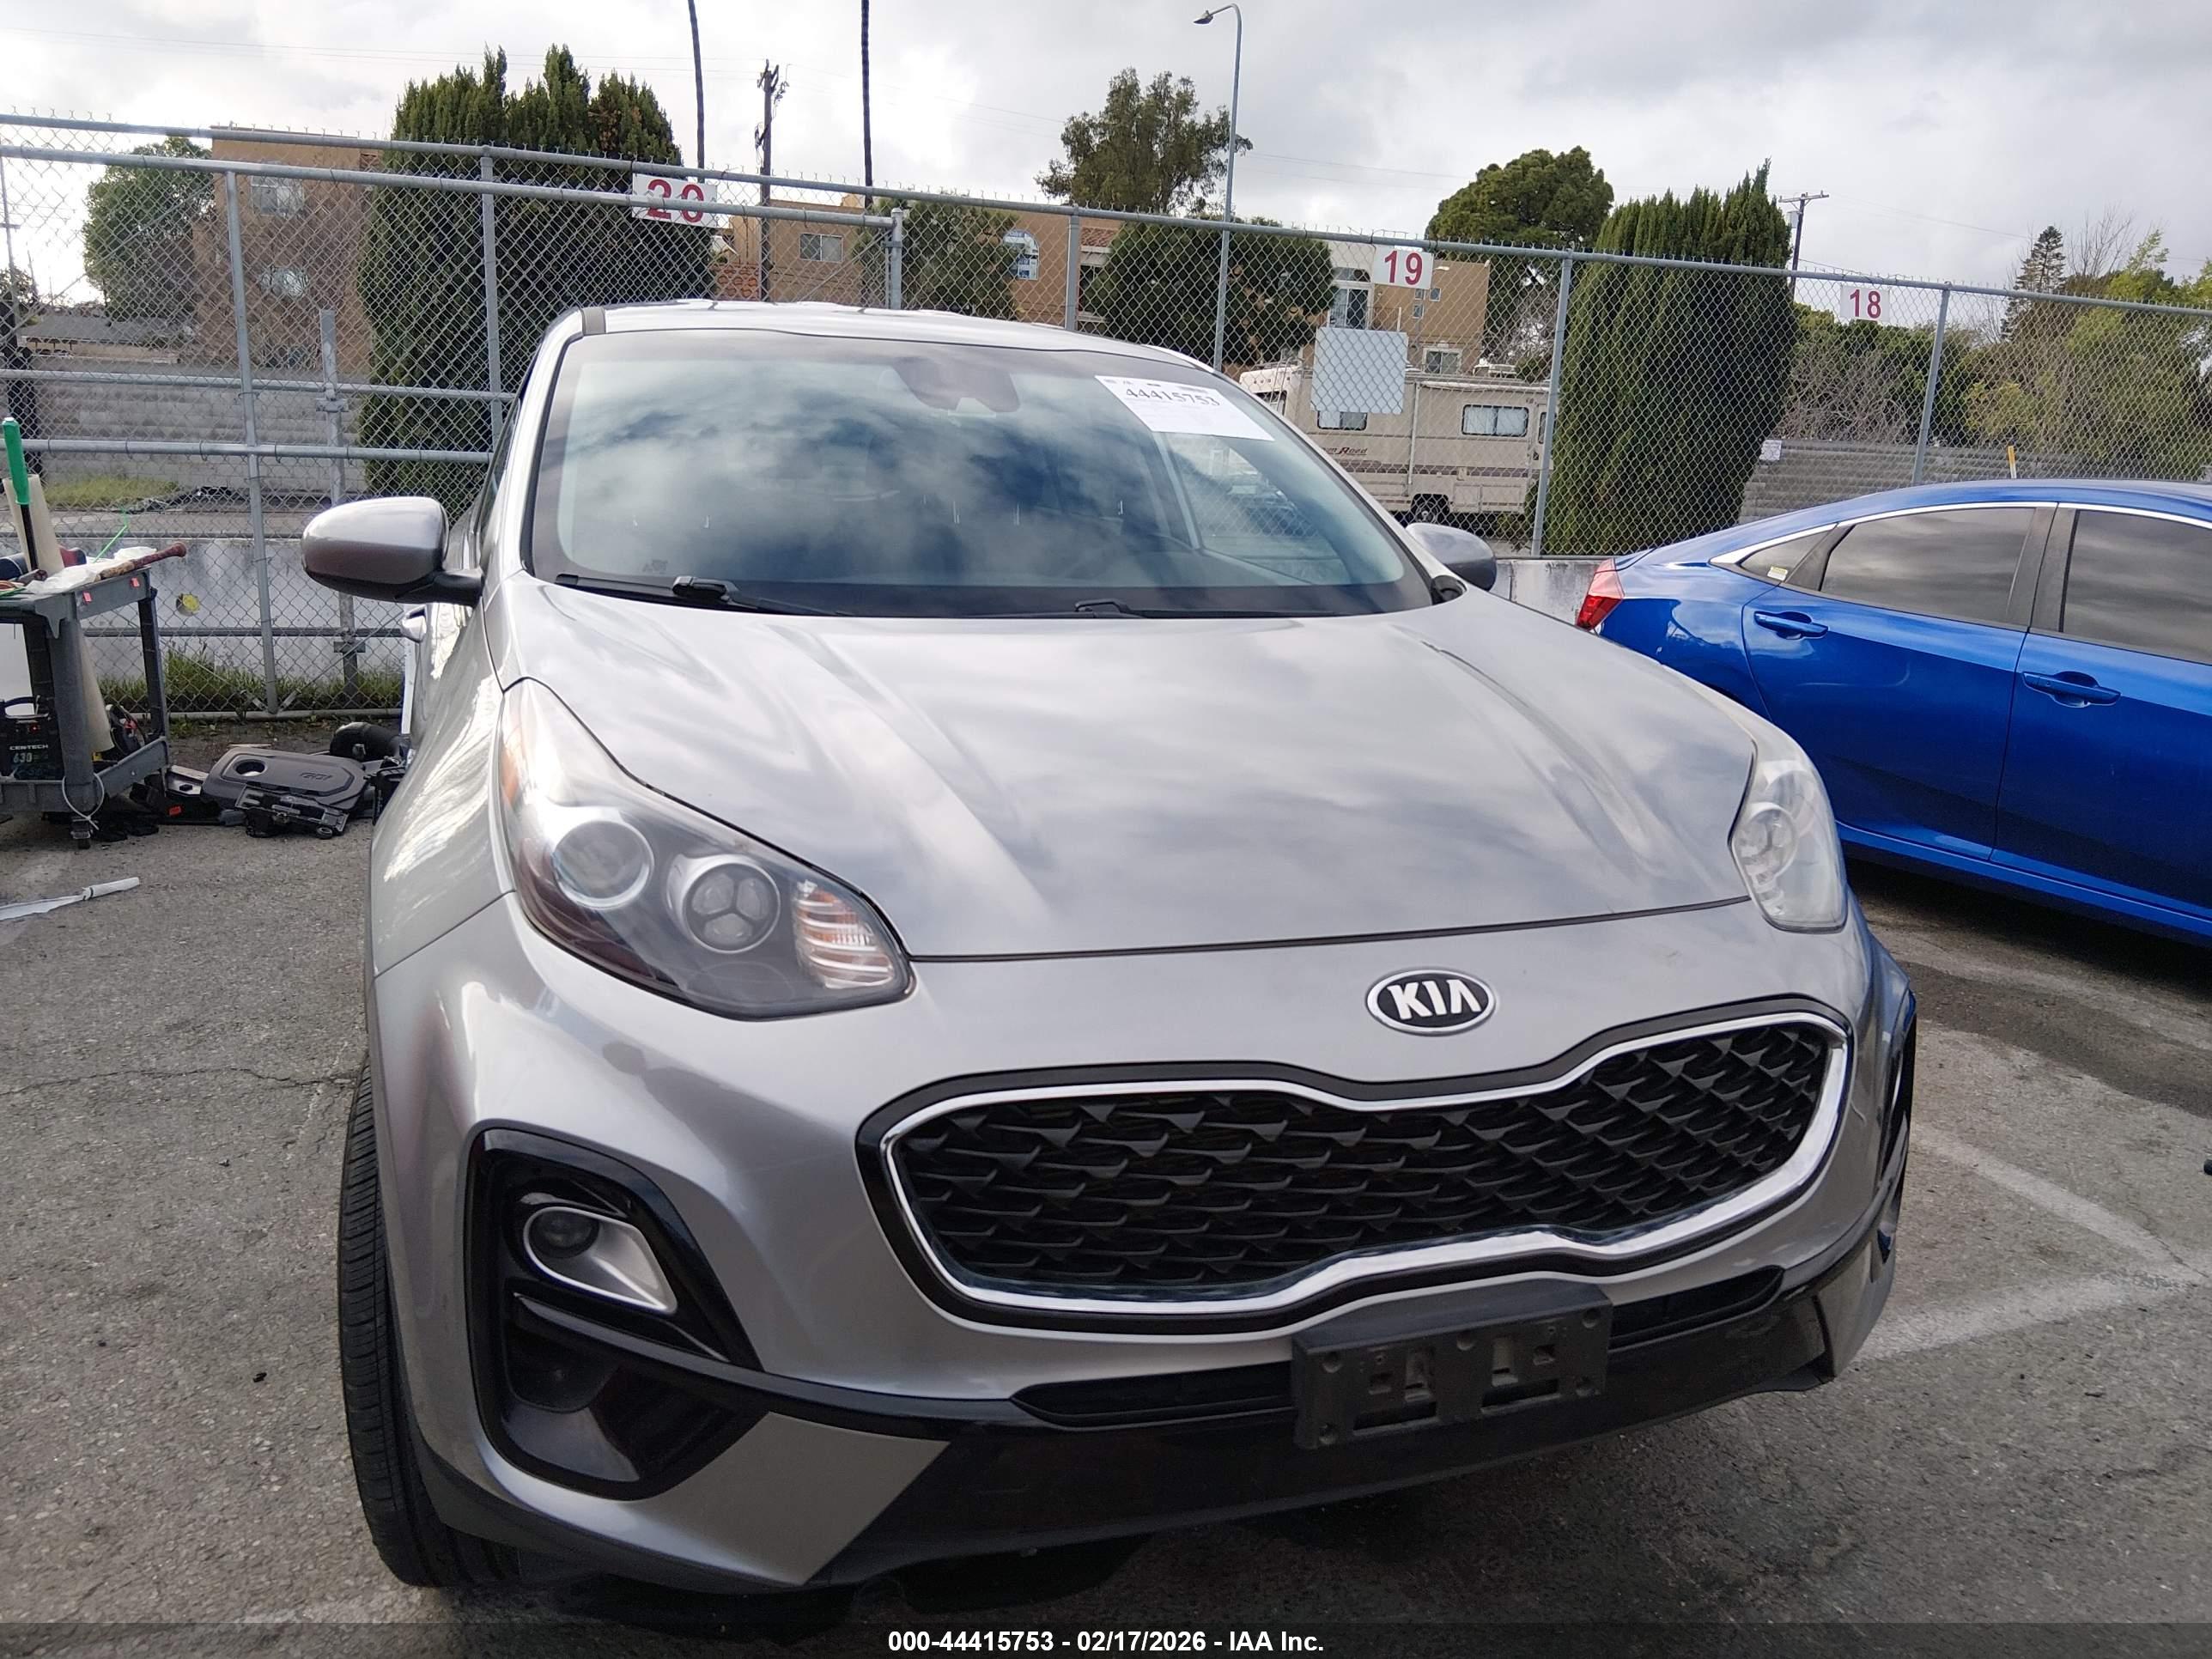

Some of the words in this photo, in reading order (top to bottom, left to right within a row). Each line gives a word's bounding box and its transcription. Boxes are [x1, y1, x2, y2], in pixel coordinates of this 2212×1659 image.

[647, 179, 704, 223] 20
[1384, 250, 1423, 286] 19
[1850, 289, 1881, 319] 18
[1126, 388, 1220, 406] 44415753
[13, 752, 33, 763] 630
[1386, 979, 1482, 1020] KIA
